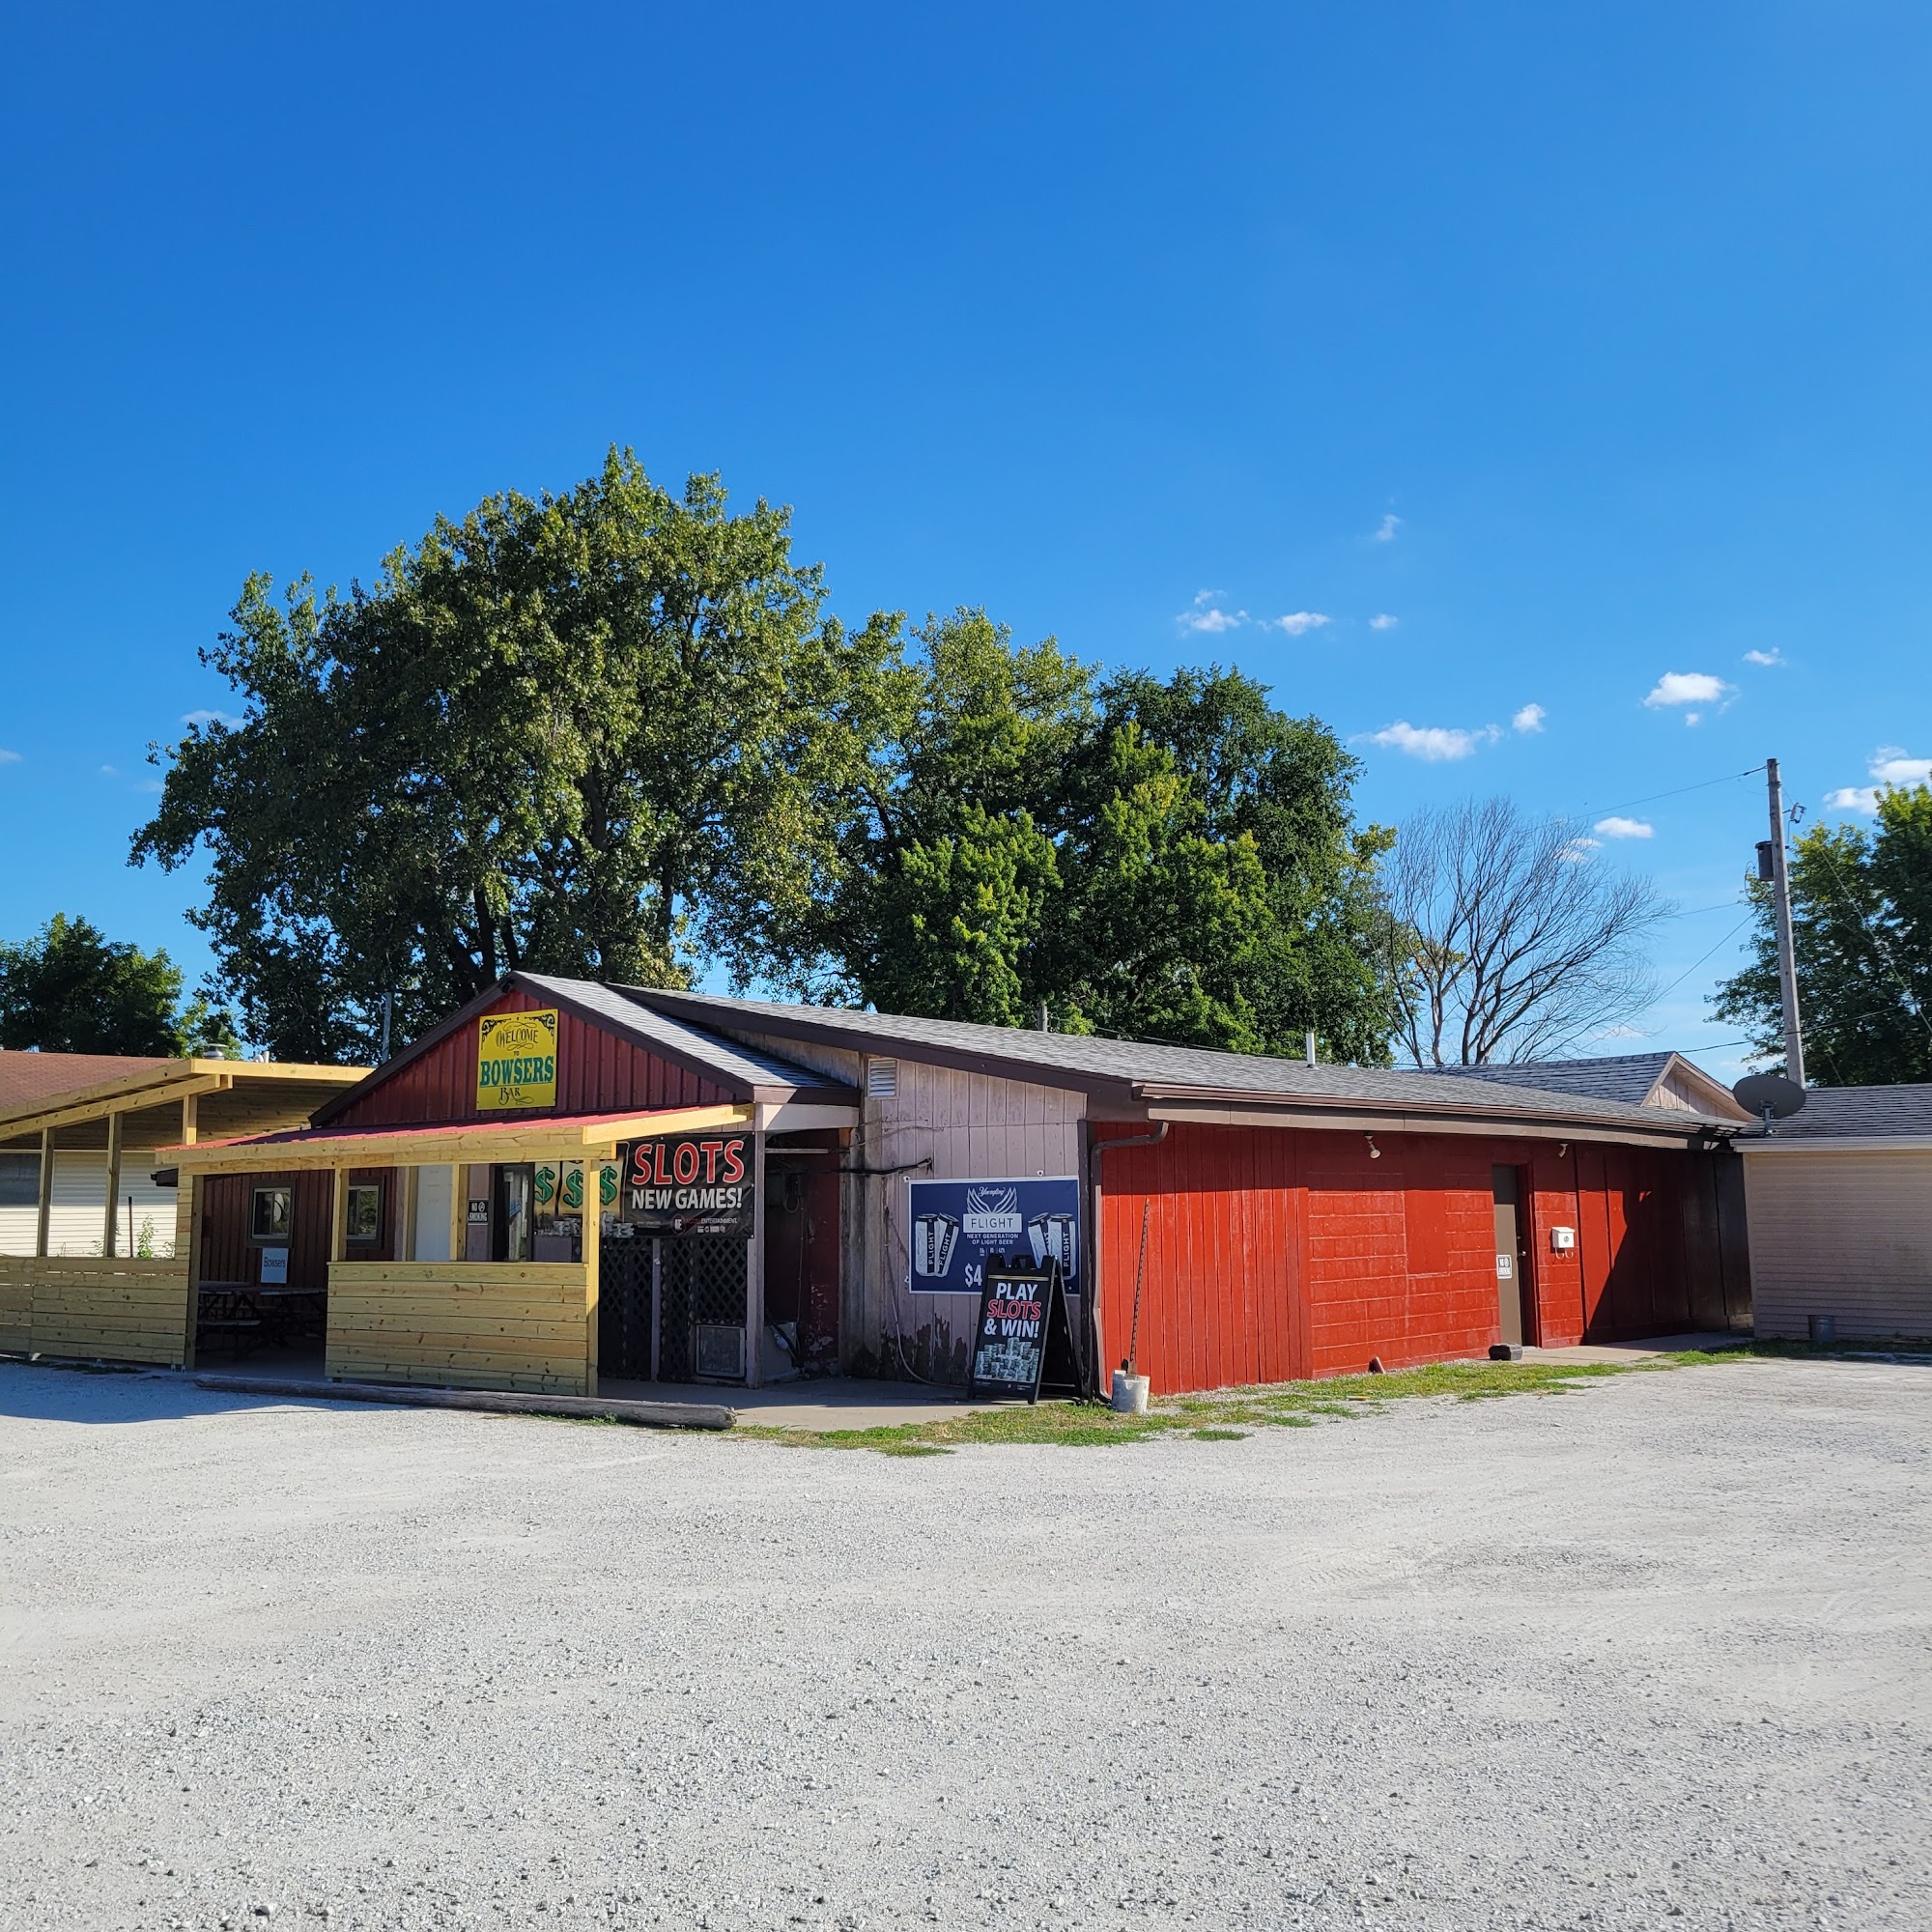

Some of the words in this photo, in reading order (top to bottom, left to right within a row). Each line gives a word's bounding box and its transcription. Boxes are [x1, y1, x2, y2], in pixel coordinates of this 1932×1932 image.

[496, 1028, 539, 1048] WELCOME
[480, 1055, 554, 1086] BOWSERS
[498, 1087, 523, 1105] BAR
[632, 1140, 745, 1185] SLOTS
[470, 1201, 486, 1212] NO
[632, 1189, 672, 1209] NEW
[675, 1187, 743, 1209] GAMES!
[469, 1211, 488, 1222] SMOKING
[971, 1218, 1013, 1229] FLIGHT
[939, 1233, 952, 1266] FLIGHT
[264, 1257, 286, 1267] Bowsers
[964, 1263, 982, 1288] $4
[996, 1282, 1038, 1301] PLAY
[986, 1298, 1041, 1321] SLOTS
[983, 1318, 997, 1335] &
[1001, 1319, 1040, 1339] WIN!
